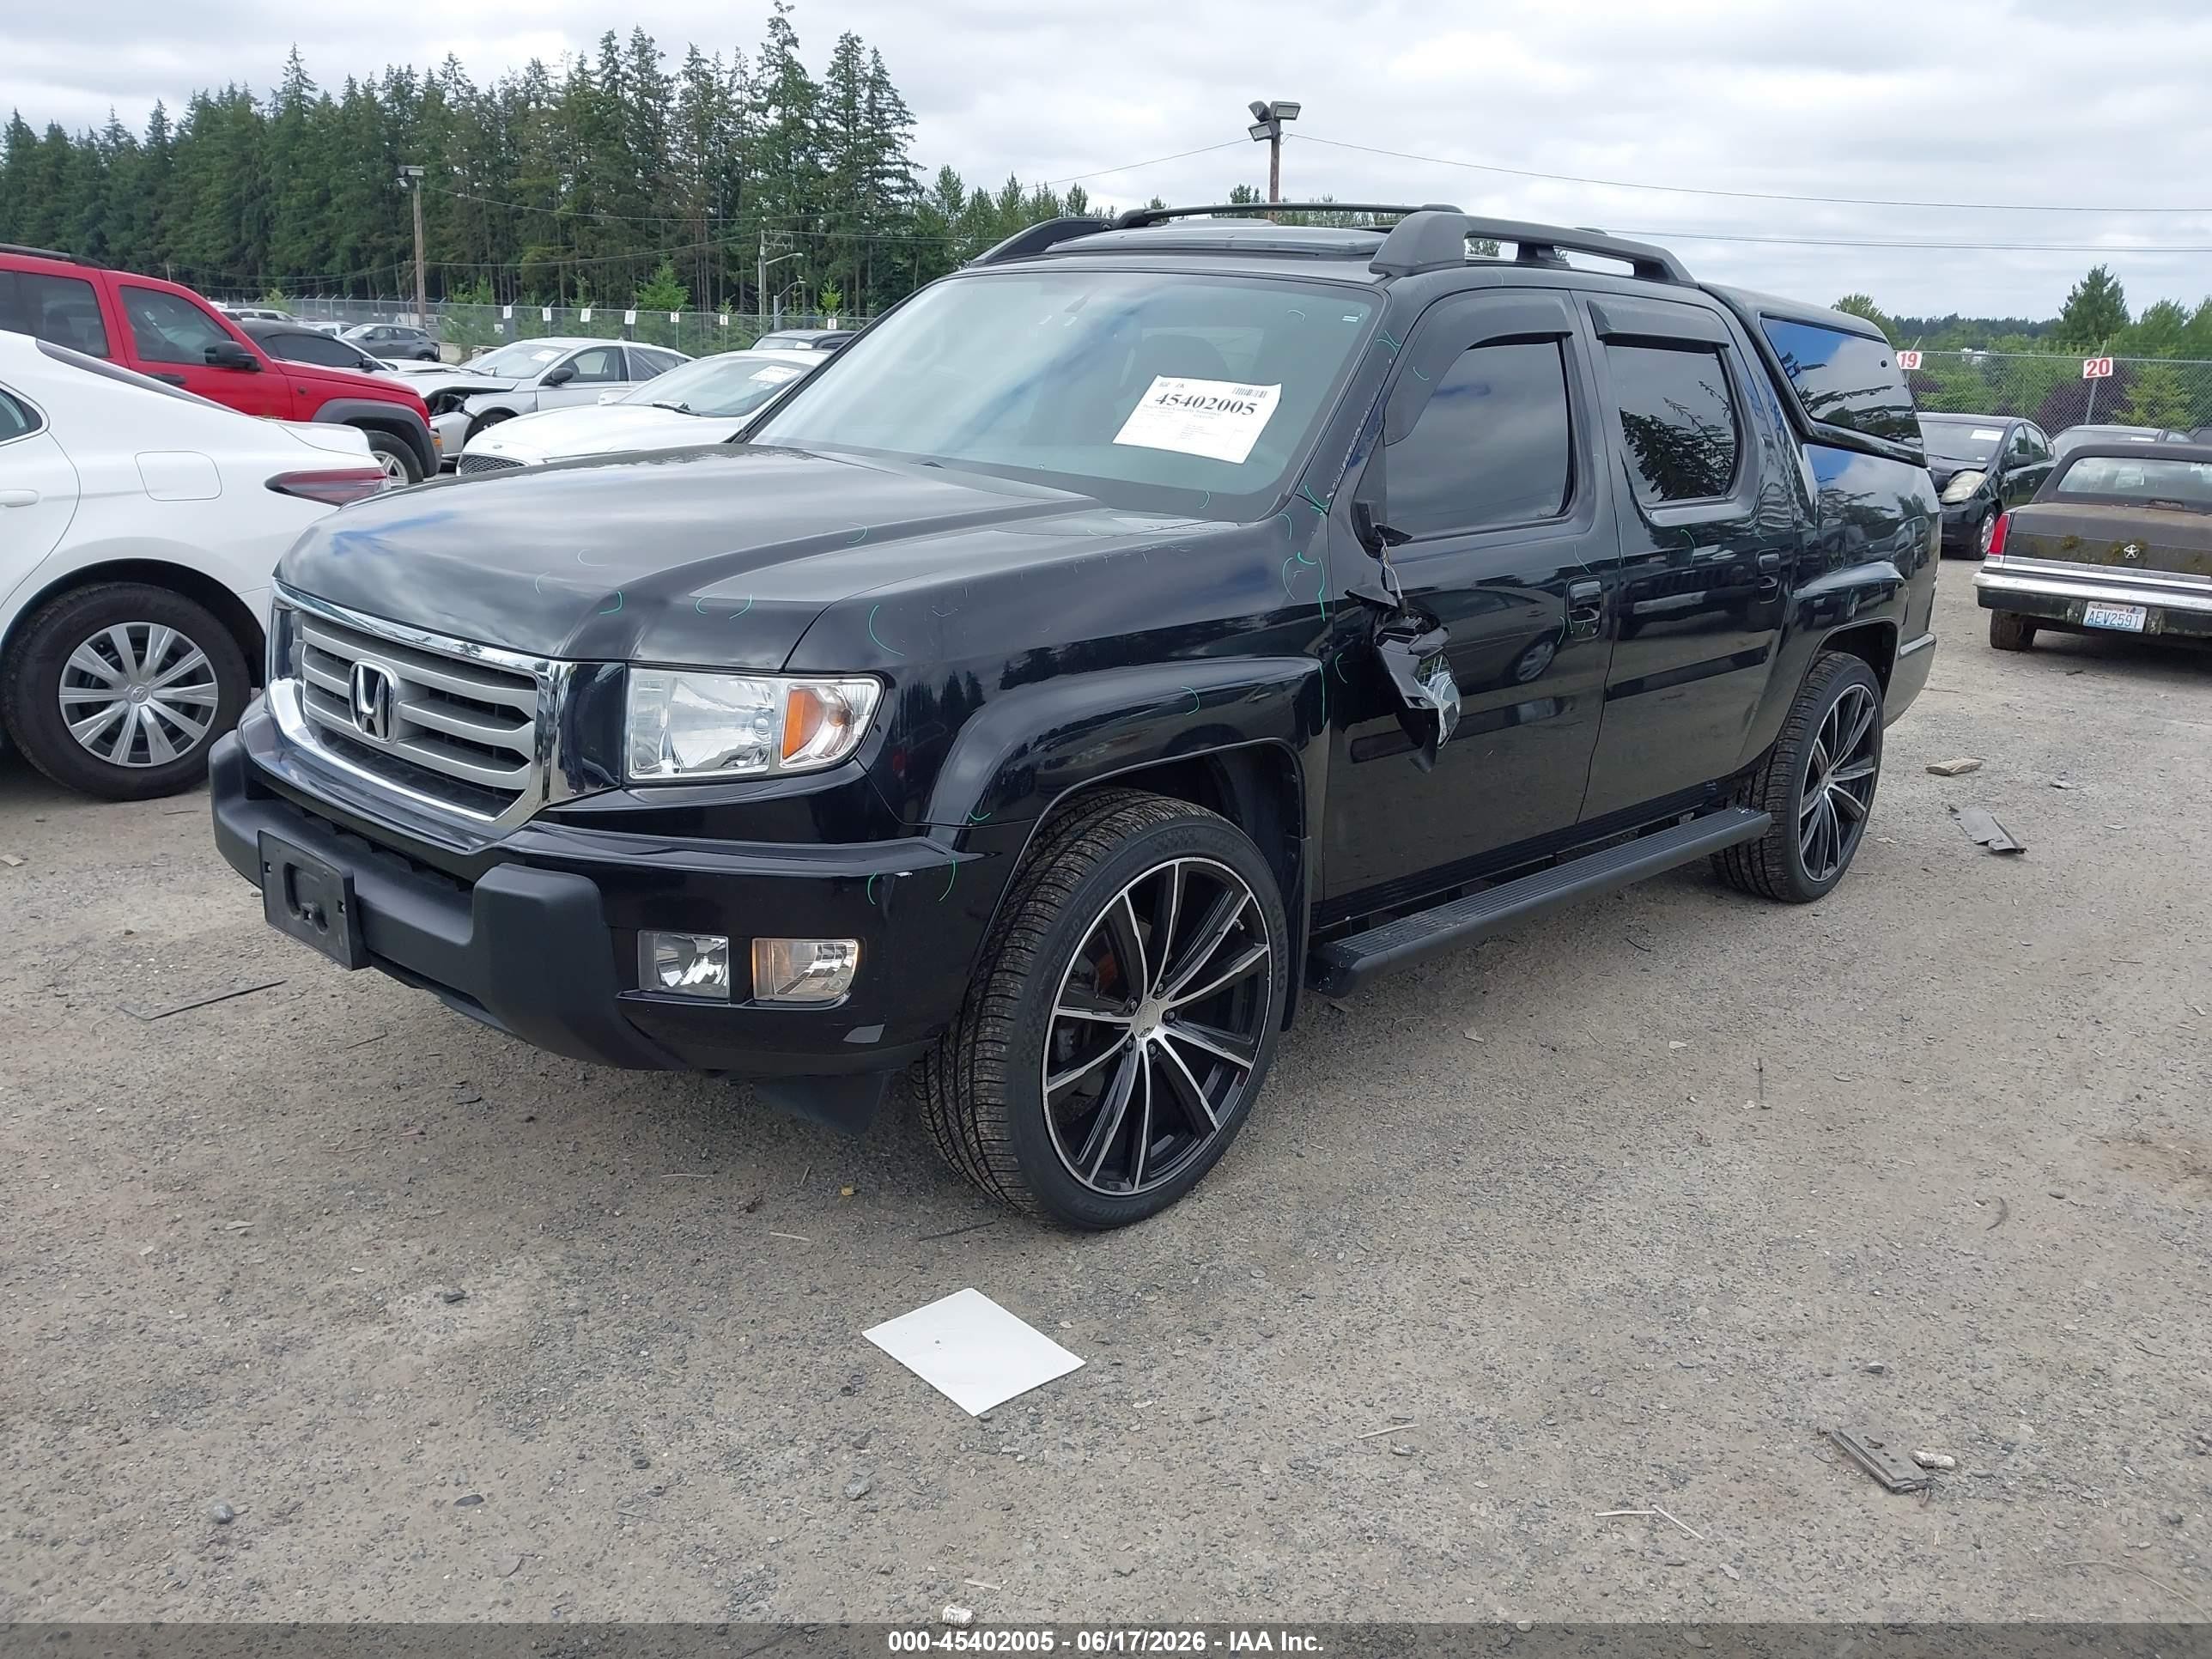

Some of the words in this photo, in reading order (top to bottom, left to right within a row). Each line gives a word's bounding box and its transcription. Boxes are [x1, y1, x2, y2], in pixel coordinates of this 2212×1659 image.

[1900, 353, 1917, 368] 19
[2087, 359, 2110, 376] 20
[1154, 392, 1258, 416] 45402005
[2087, 611, 2139, 629] AEV2591
